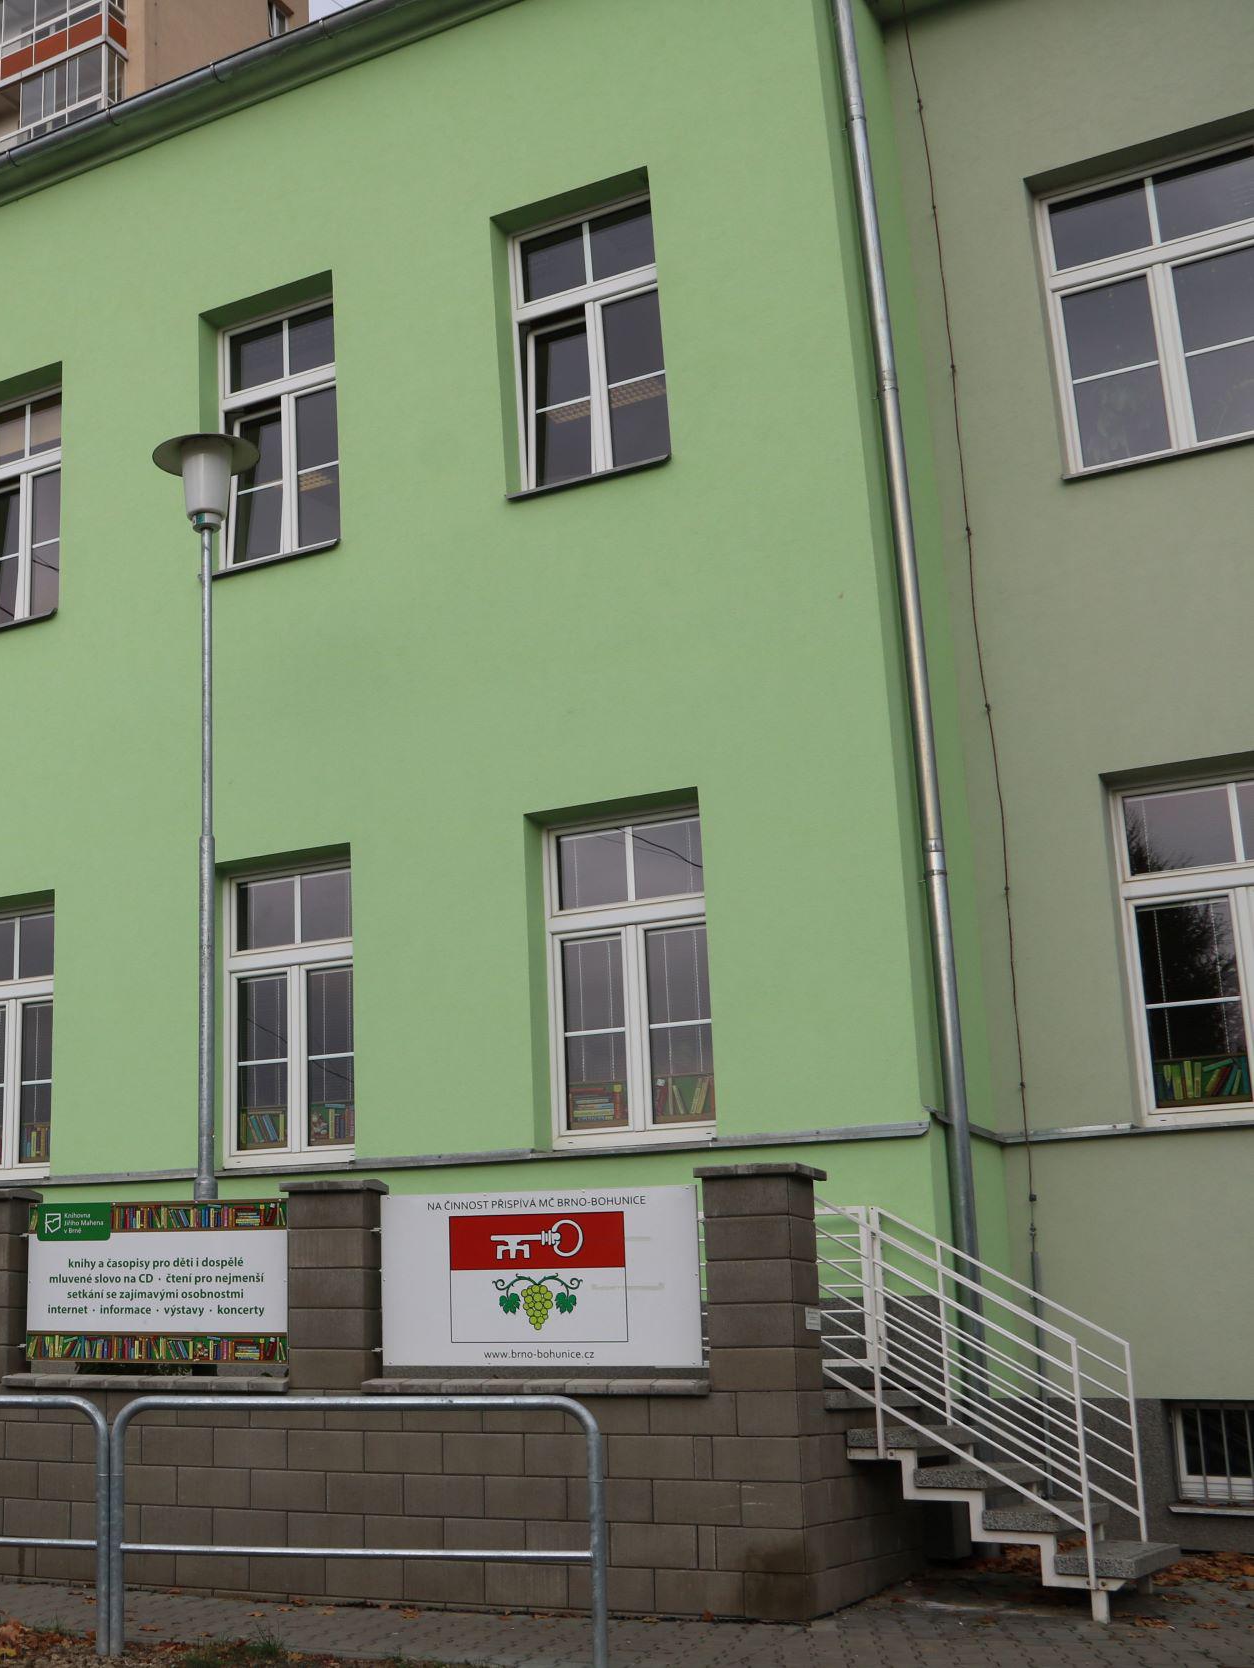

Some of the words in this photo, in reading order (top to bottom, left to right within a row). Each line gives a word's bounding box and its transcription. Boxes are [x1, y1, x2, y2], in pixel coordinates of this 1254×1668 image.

[427, 1203, 442, 1211] NA
[444, 1200, 489, 1211] ČINNOST
[491, 1198, 537, 1209] PŘISPÍVÁ
[538, 1197, 554, 1208] MČ
[557, 1195, 646, 1207] BRNO-BOHUNICE
[68, 1258, 96, 1270] knihy
[106, 1258, 150, 1270] časopisy
[152, 1260, 171, 1269] pro
[173, 1257, 194, 1267] děti
[201, 1256, 244, 1269] dospělé
[49, 1273, 93, 1283] mluvené
[94, 1273, 122, 1283] slovo
[123, 1275, 136, 1283] na
[138, 1273, 154, 1283] CD
[166, 1273, 192, 1283] čtení
[194, 1275, 213, 1285] pro
[215, 1272, 265, 1285] nejmenší
[67, 1288, 104, 1299] setkání
[106, 1291, 117, 1299] se
[119, 1288, 179, 1301] zajímavými
[181, 1288, 244, 1299] osobnostmi
[47, 1304, 88, 1314] internet
[100, 1304, 152, 1314] informace
[164, 1304, 205, 1316] výstavy
[217, 1304, 265, 1317] koncerty
[484, 1348, 595, 1359] www.brno-bohunice.cz
